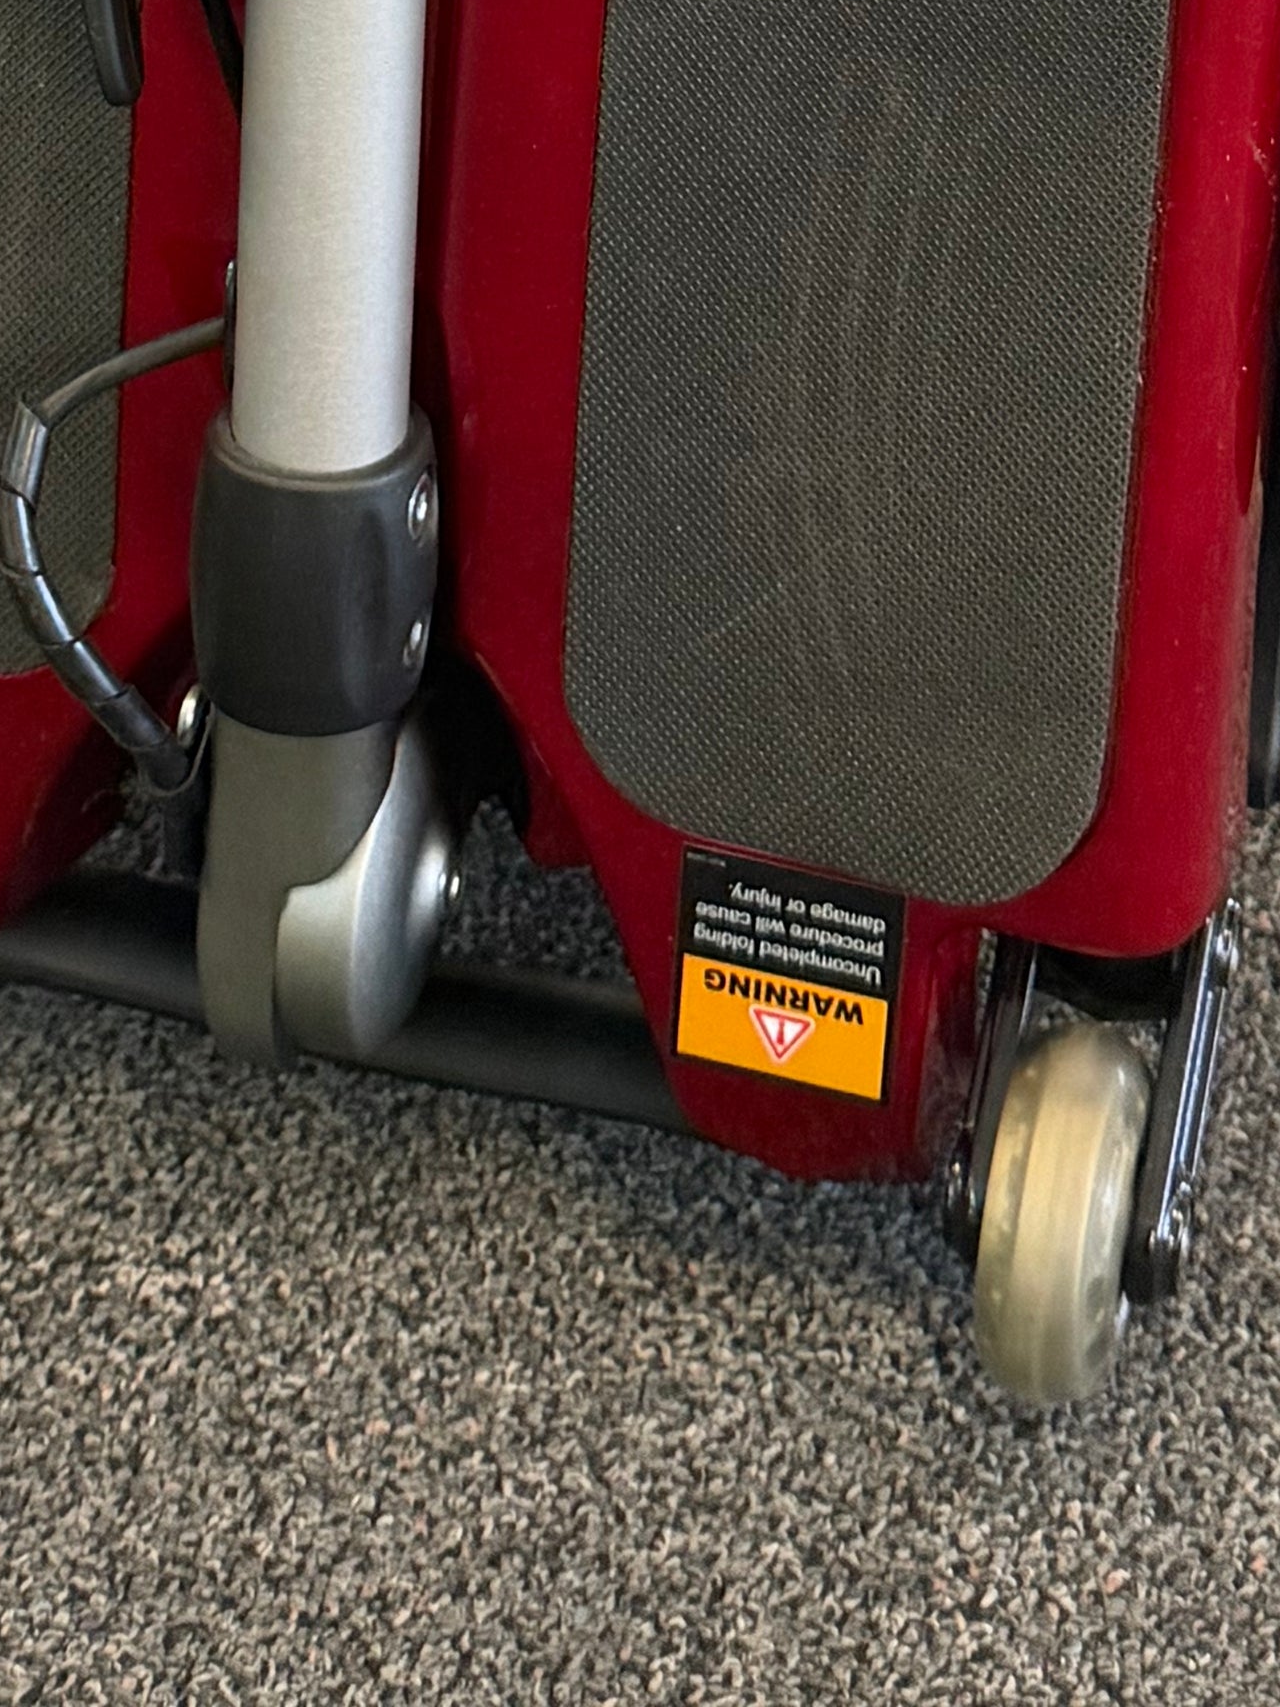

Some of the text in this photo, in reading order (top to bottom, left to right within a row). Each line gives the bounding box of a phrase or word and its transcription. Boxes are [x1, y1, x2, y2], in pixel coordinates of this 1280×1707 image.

[695, 901, 884, 958] procedure will cause
[728, 881, 886, 936] damage or injury.
[693, 921, 881, 986] Uncompleted folding
[704, 968, 864, 1026] WARNING
